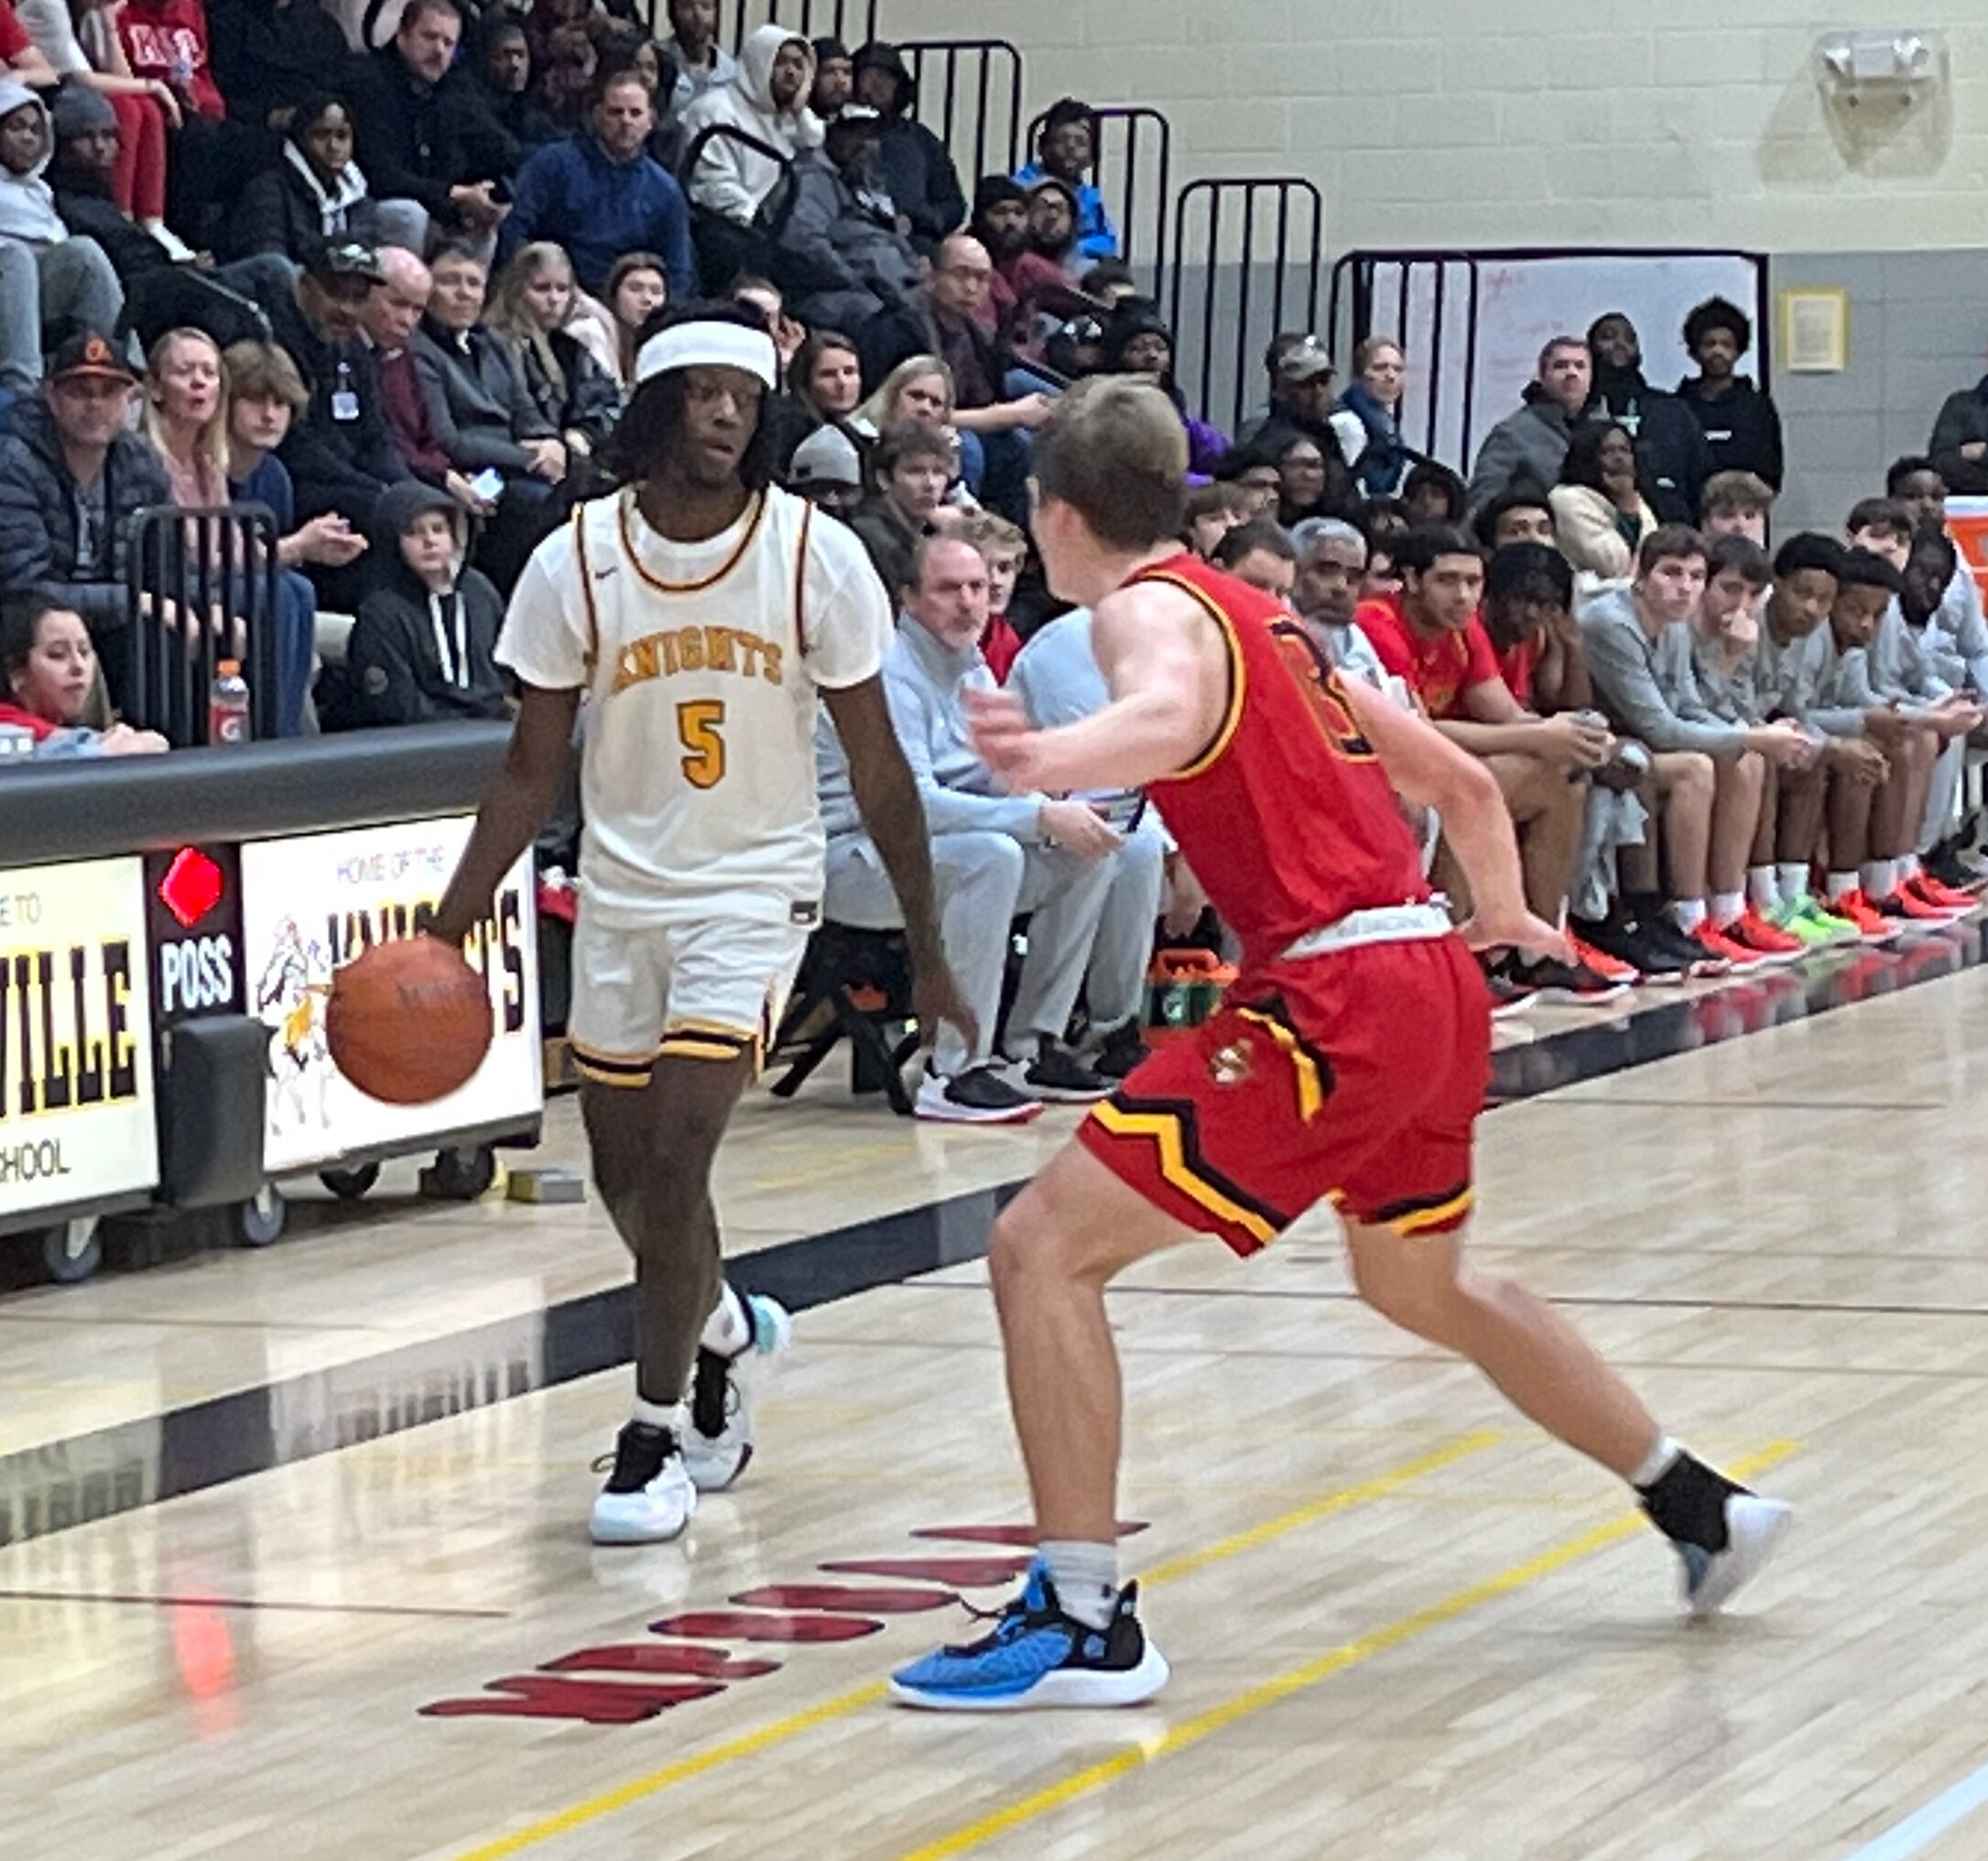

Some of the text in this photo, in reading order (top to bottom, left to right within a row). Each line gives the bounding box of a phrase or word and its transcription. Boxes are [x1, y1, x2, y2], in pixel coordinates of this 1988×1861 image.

[676, 699, 726, 789] 5
[15, 891, 42, 926] TO
[161, 936, 234, 1012] POSS
